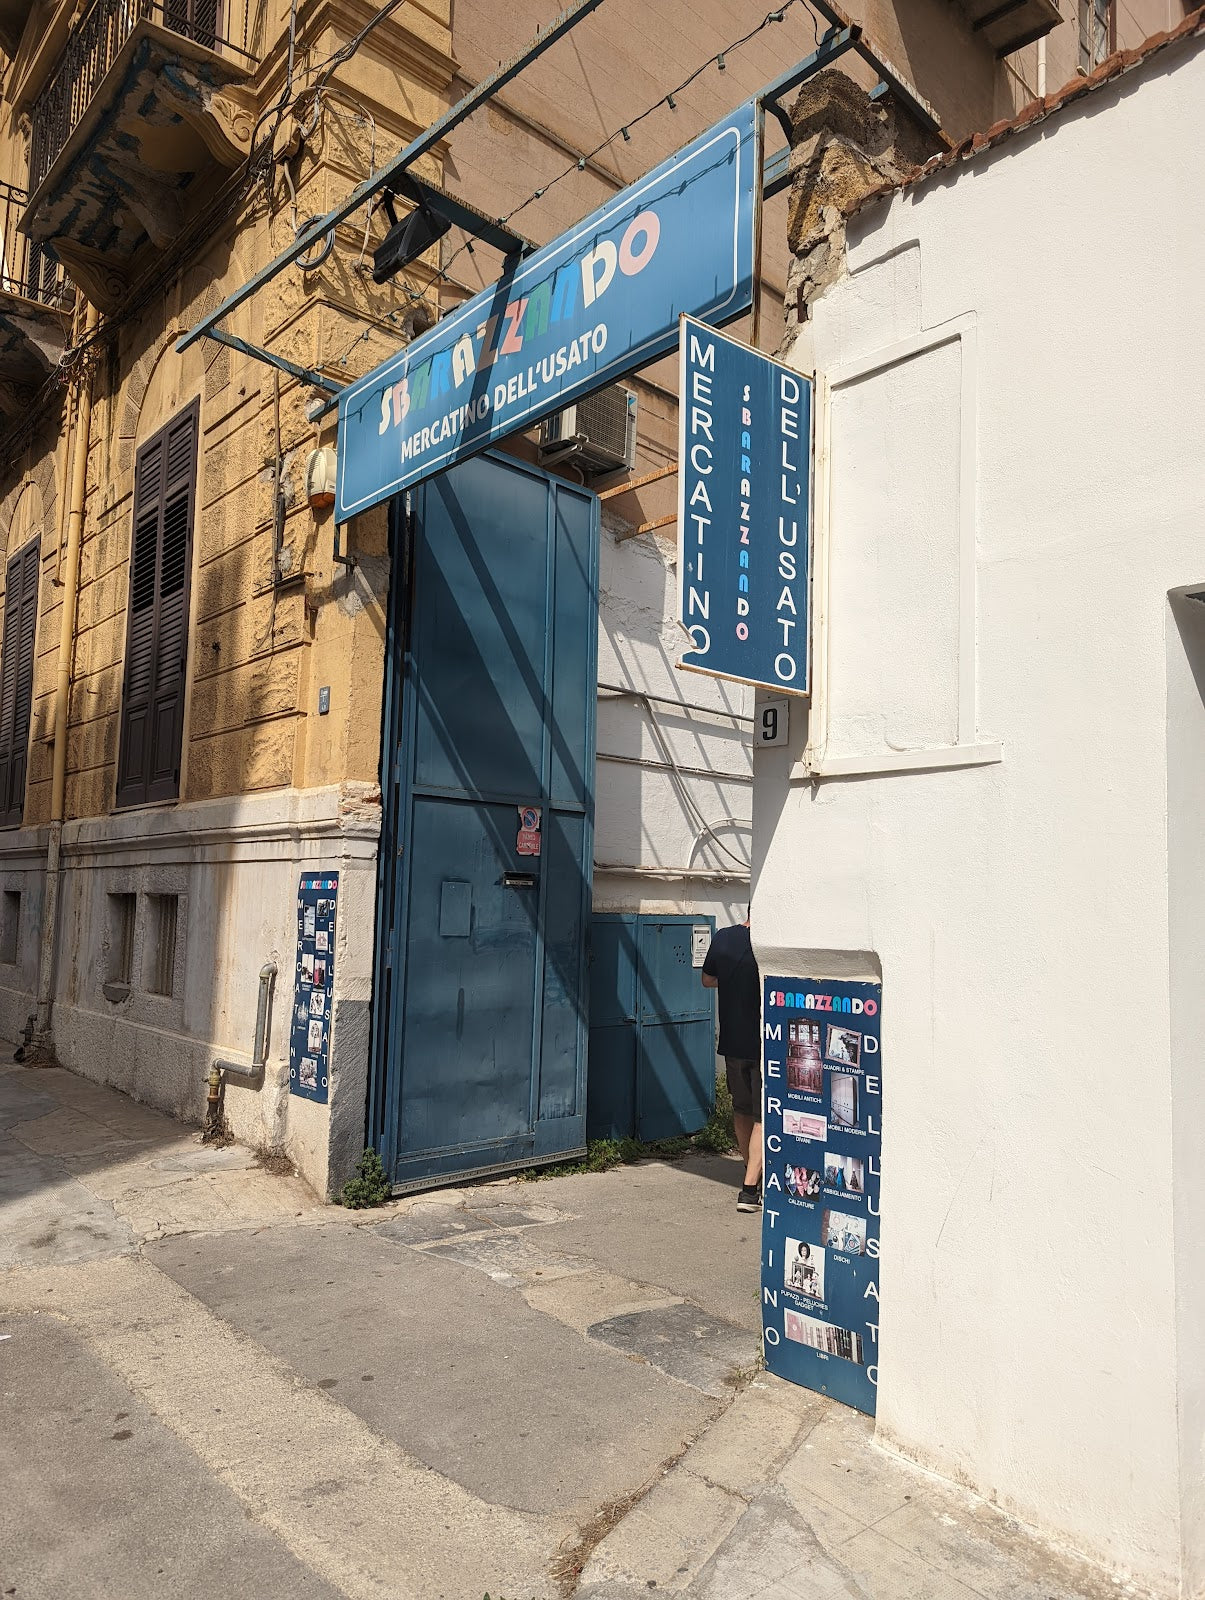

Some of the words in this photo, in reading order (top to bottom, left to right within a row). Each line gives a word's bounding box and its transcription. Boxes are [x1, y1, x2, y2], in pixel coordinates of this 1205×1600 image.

[379, 210, 660, 436] SBARAZZANDO
[401, 394, 489, 464] MERCATINO
[494, 323, 608, 411] DELL'USATO
[689, 335, 715, 655] MERCATINO
[735, 384, 752, 641] SBARAZZANDO
[762, 708, 778, 741] 9
[769, 990, 878, 1016] SBARAZZANDO
[827, 1124, 843, 1132] MOBILI
[764, 1023, 782, 1346] MERCATINO
[823, 1187, 862, 1202] ABBIGLIAMENTO
[788, 1198, 815, 1210] CALZATURE
[833, 1254, 851, 1265] DISCHI
